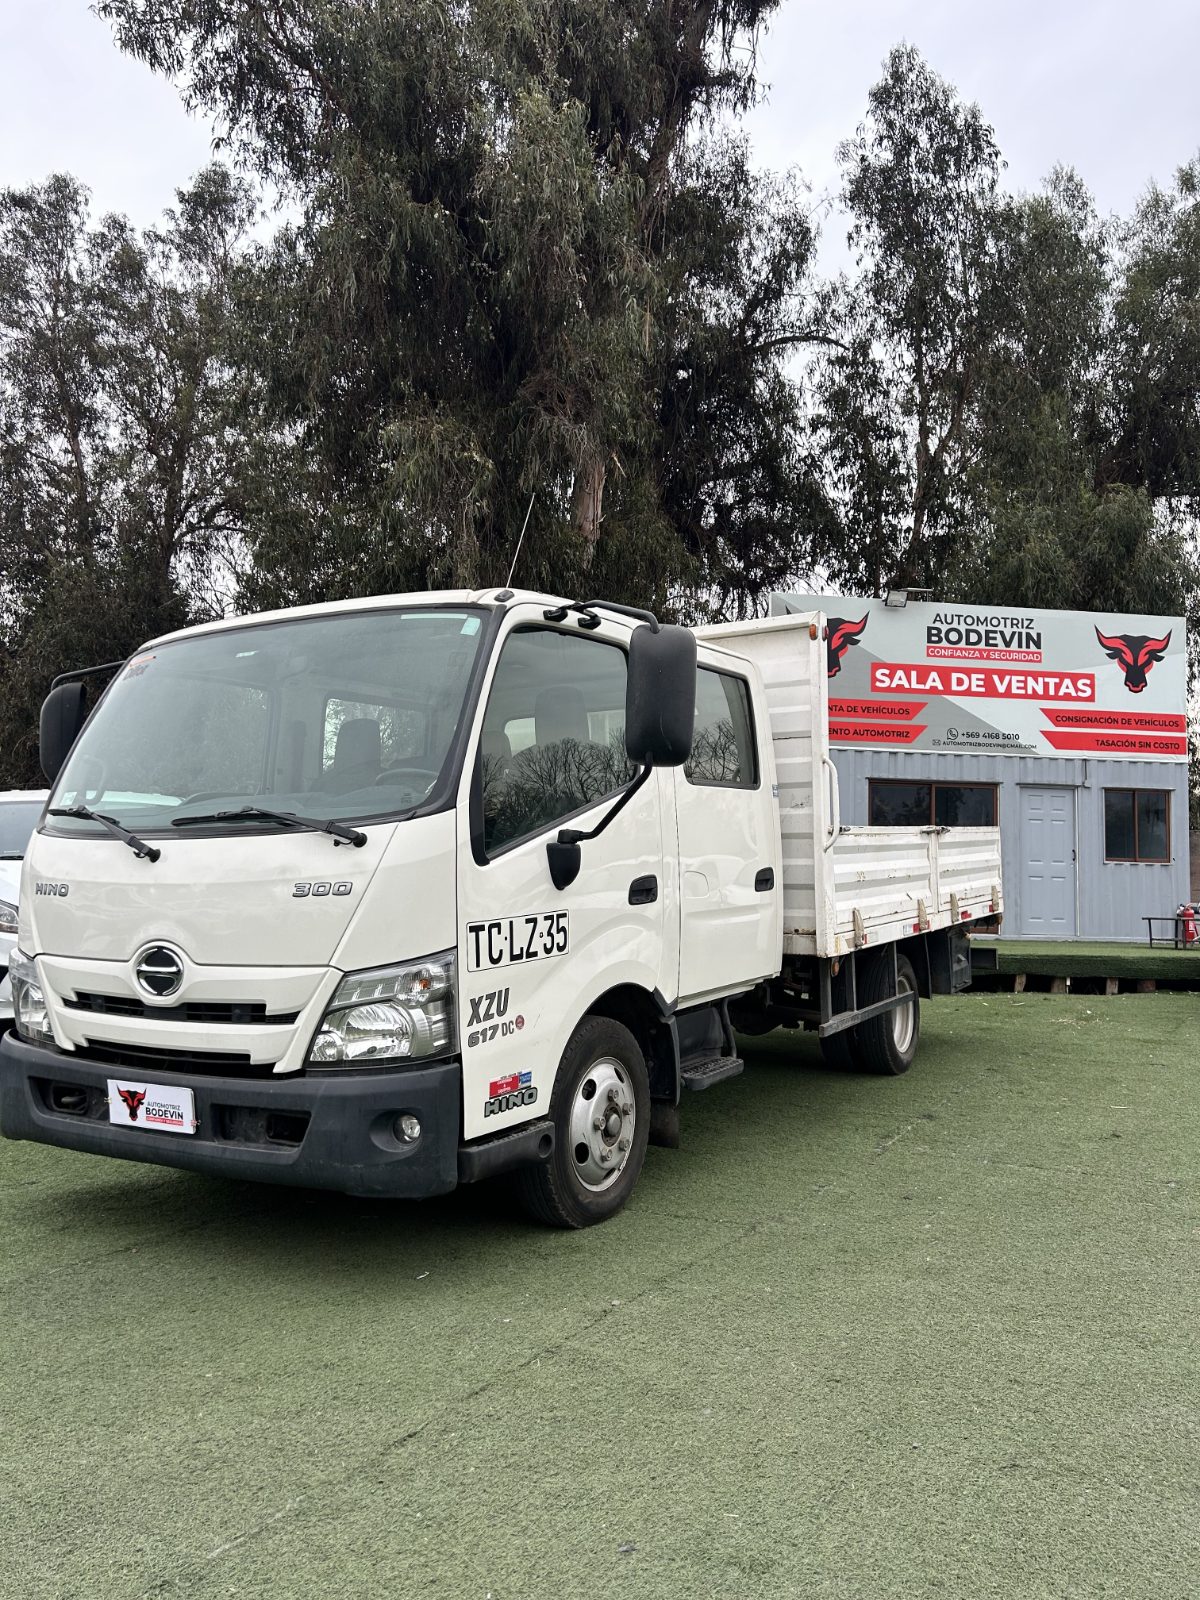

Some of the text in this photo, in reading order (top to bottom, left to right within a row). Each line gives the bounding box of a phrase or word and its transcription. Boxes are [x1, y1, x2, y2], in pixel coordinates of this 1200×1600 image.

[932, 613, 1035, 630] AUTOMOTRIZ
[926, 626, 1042, 650] BODEVIN
[928, 648, 980, 658] CONFIANZA
[989, 651, 1041, 661] SEGURIDAD
[874, 668, 1092, 697] SALA DE VENTAS
[860, 705, 910, 715] VEHÍCULOS
[1055, 715, 1119, 725] CONSIGNACIÓN
[1134, 718, 1180, 727] VEHÍCULOS
[852, 728, 910, 738] AUTOMOTRIZ
[961, 731, 980, 739] +569
[1095, 739, 1136, 748] TASACIÓN
[1153, 741, 1180, 750] COSTO
[35, 882, 69, 897] HINO
[292, 881, 353, 897] 300
[467, 987, 510, 1027] XZU
[467, 1023, 499, 1048] 617
[501, 1020, 514, 1037] DC
[147, 1101, 181, 1111] AUTOMOTRIZ
[484, 1086, 538, 1118] HINO
[145, 1106, 184, 1120] BODEVIN
